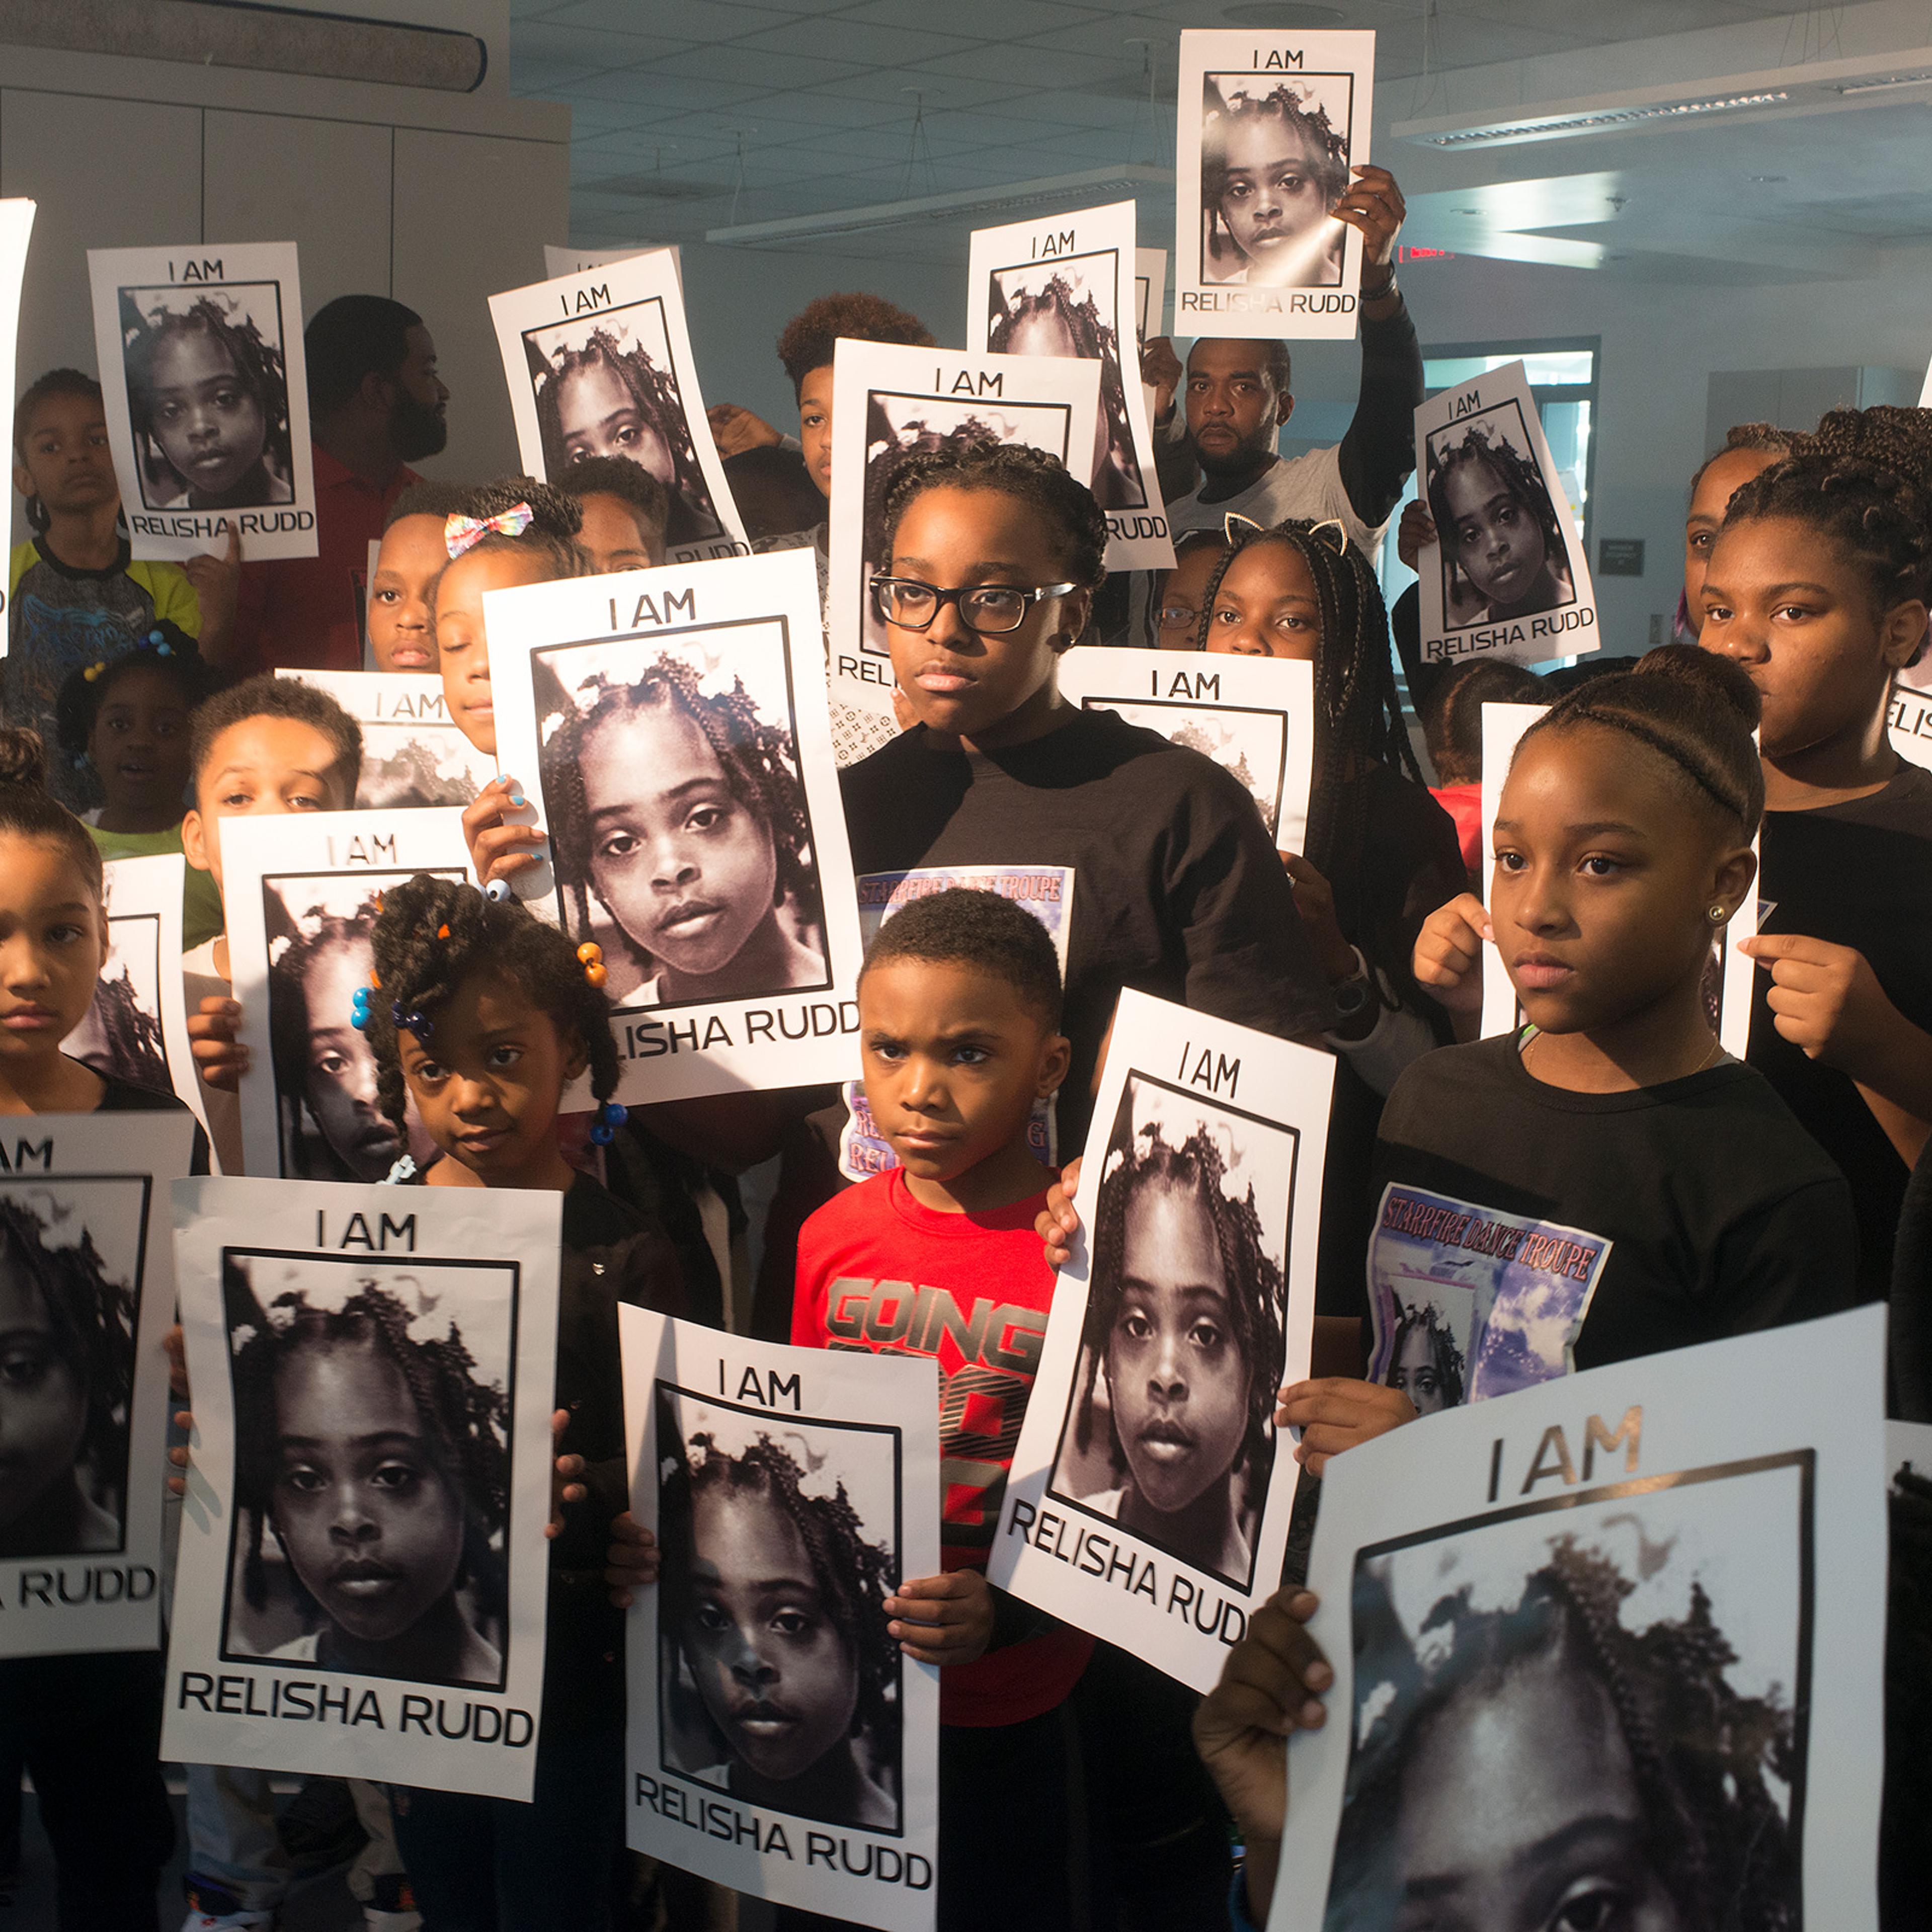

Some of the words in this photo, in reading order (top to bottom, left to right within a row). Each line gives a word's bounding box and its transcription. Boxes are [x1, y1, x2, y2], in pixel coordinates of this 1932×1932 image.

[1253, 49, 1258, 69] I
[1265, 49, 1304, 70] AM
[1032, 237, 1036, 259] I
[1041, 229, 1076, 257] AM
[169, 261, 175, 282] I
[183, 259, 224, 281] AM
[560, 294, 569, 316] I
[576, 283, 611, 313] AM
[1290, 294, 1356, 314] RUDD
[935, 367, 941, 392] I
[950, 371, 1004, 398] AM
[1448, 401, 1453, 421] I
[1457, 390, 1482, 417] AM
[131, 515, 229, 538] RELISHA
[240, 511, 314, 535] RUDD
[1106, 516, 1167, 540] RUDD
[609, 598, 617, 631] I
[630, 588, 697, 628] AM
[1426, 622, 1525, 659] RELISHA
[1531, 607, 1594, 638] RUDD
[1152, 670, 1157, 696] I
[1168, 671, 1221, 700] AM
[376, 692, 382, 717] I
[392, 693, 443, 718] AM
[327, 835, 336, 867] I
[349, 833, 399, 865] AM
[1000, 875, 1063, 902] TROUPE
[745, 1001, 861, 1044] RUDD
[1178, 1041, 1190, 1080] I
[1190, 1049, 1241, 1099] AM
[316, 1210, 325, 1248] I
[340, 1212, 418, 1252] AM
[1383, 1196, 1473, 1247] STARRFIRE
[1463, 1217, 1527, 1260] DANCE
[1518, 1232, 1596, 1282] TROUPE
[825, 1276, 1049, 1376] GOING
[719, 1358, 725, 1396] I
[737, 1366, 801, 1410] AM
[1487, 1438, 1504, 1503] I
[1520, 1405, 1643, 1495] AM
[20, 1565, 156, 1608] RUDD
[1007, 1499, 1158, 1605] RELISHA
[1167, 1574, 1254, 1648] RUD
[178, 1671, 385, 1730] RELISHA
[399, 1695, 534, 1749] RUDD
[634, 1772, 793, 1861] RELISHA
[807, 1830, 932, 1891] RUDD
